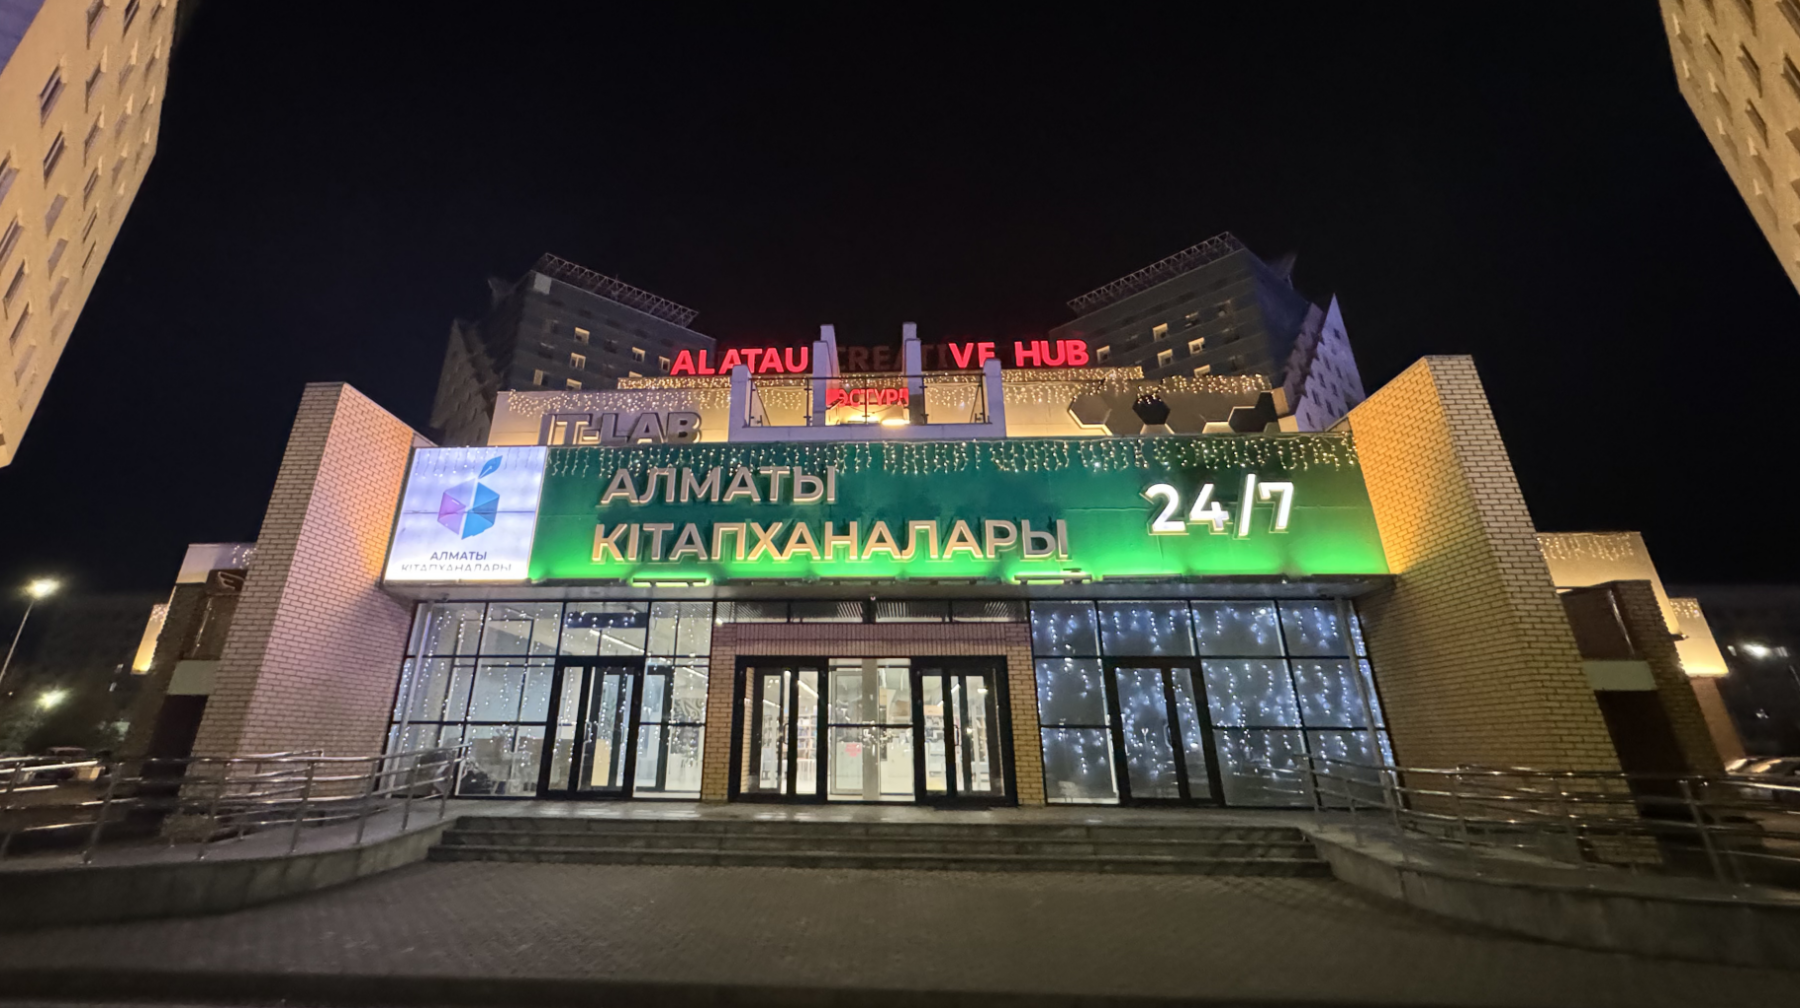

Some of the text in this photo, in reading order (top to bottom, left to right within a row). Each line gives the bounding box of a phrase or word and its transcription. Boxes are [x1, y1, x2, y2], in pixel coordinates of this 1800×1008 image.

[670, 346, 808, 375] ALATAU
[1014, 340, 1089, 367] HUB
[538, 412, 702, 446] IT-LAB
[600, 466, 836, 504] АЛМАТЫ
[1145, 473, 1294, 537] 24/7
[430, 551, 487, 561] АЛМАТЫ
[592, 519, 1068, 562] КІТАПХАНАЛАРЫ
